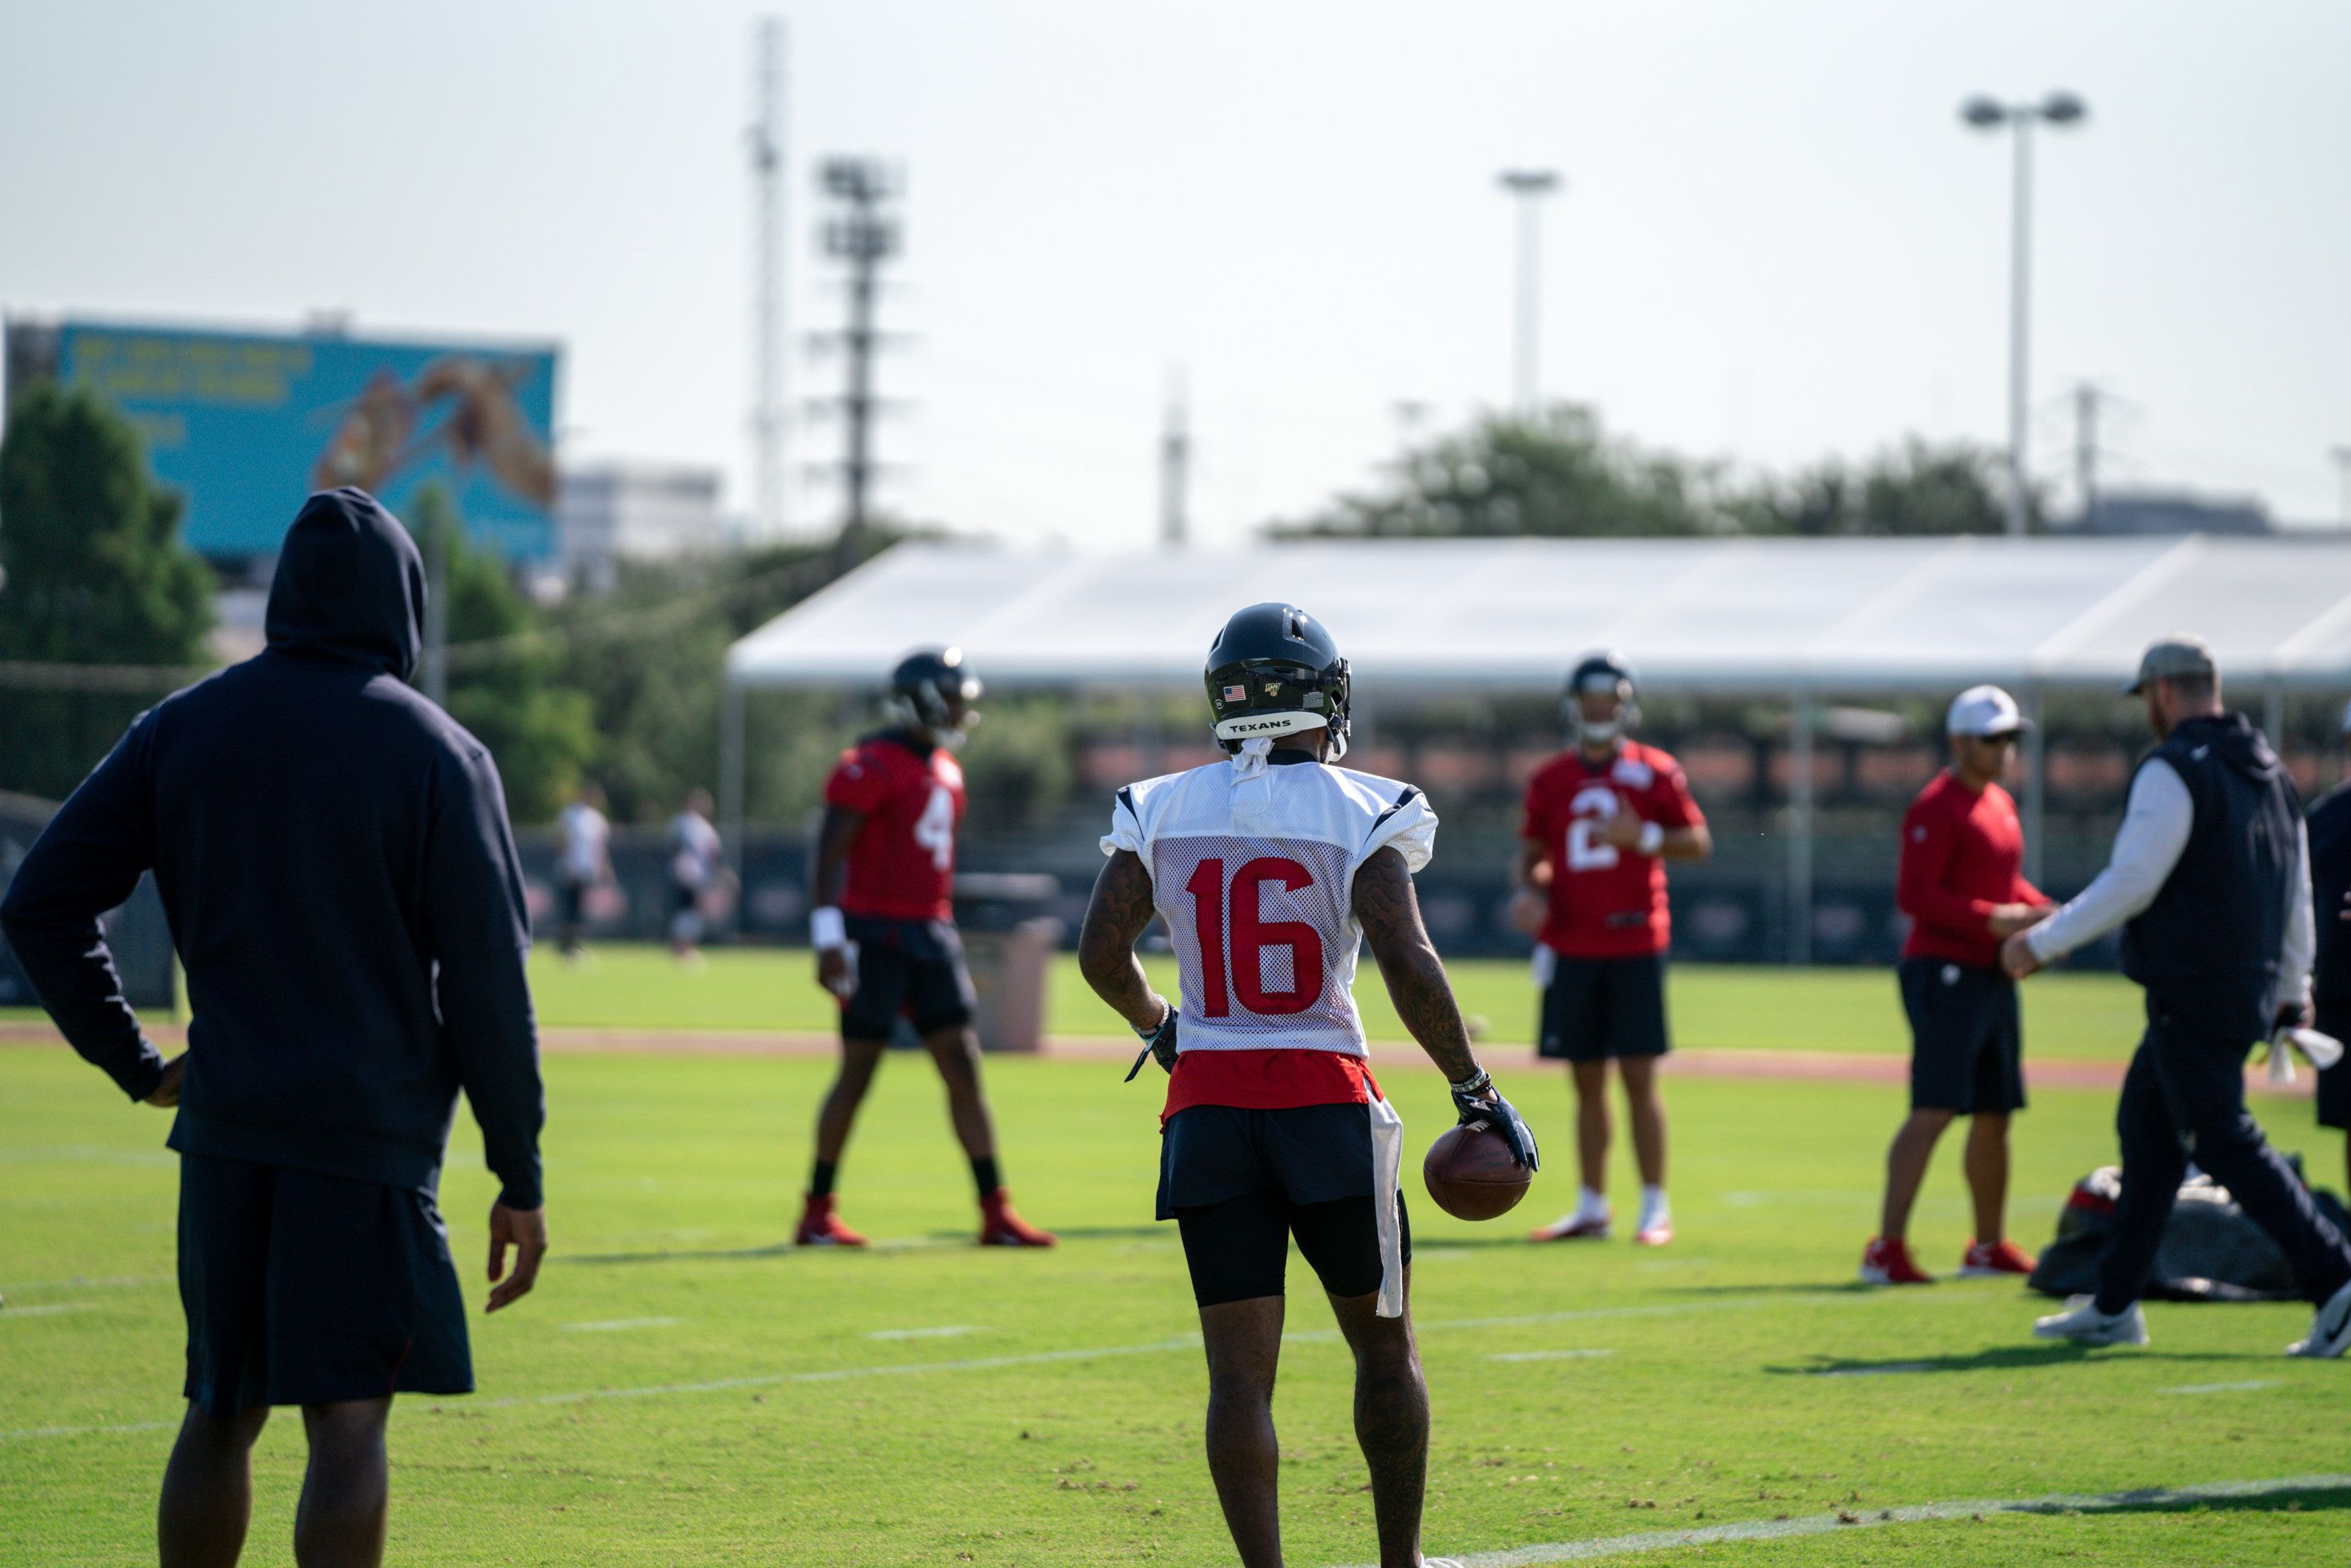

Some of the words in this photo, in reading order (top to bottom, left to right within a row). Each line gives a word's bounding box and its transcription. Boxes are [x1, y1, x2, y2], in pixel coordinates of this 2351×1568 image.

[1229, 720, 1291, 733] TEXANS
[914, 784, 955, 869] 4
[1567, 786, 1619, 871] 2
[1185, 857, 1322, 1018] 16
